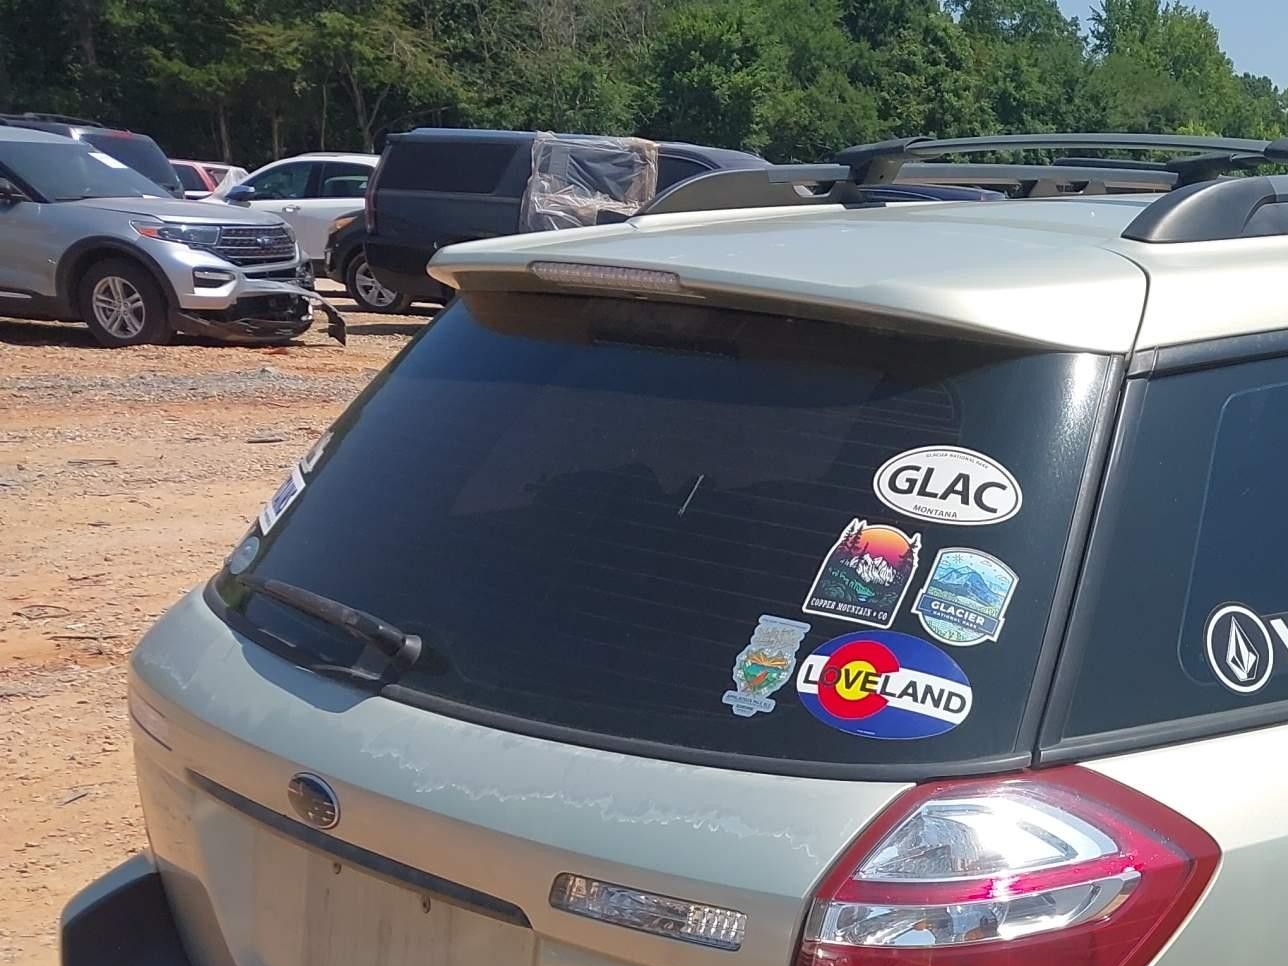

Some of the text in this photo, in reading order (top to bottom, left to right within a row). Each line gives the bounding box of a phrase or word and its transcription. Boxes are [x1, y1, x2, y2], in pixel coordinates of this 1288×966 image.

[887, 464, 1008, 514] GLAC
[912, 504, 958, 519] MONTANA
[810, 597, 888, 621] COPPER MOUNTAIN CO
[930, 600, 985, 626] GLACIER
[932, 610, 960, 624] NATIONAL
[802, 663, 967, 715] LOVELAND
